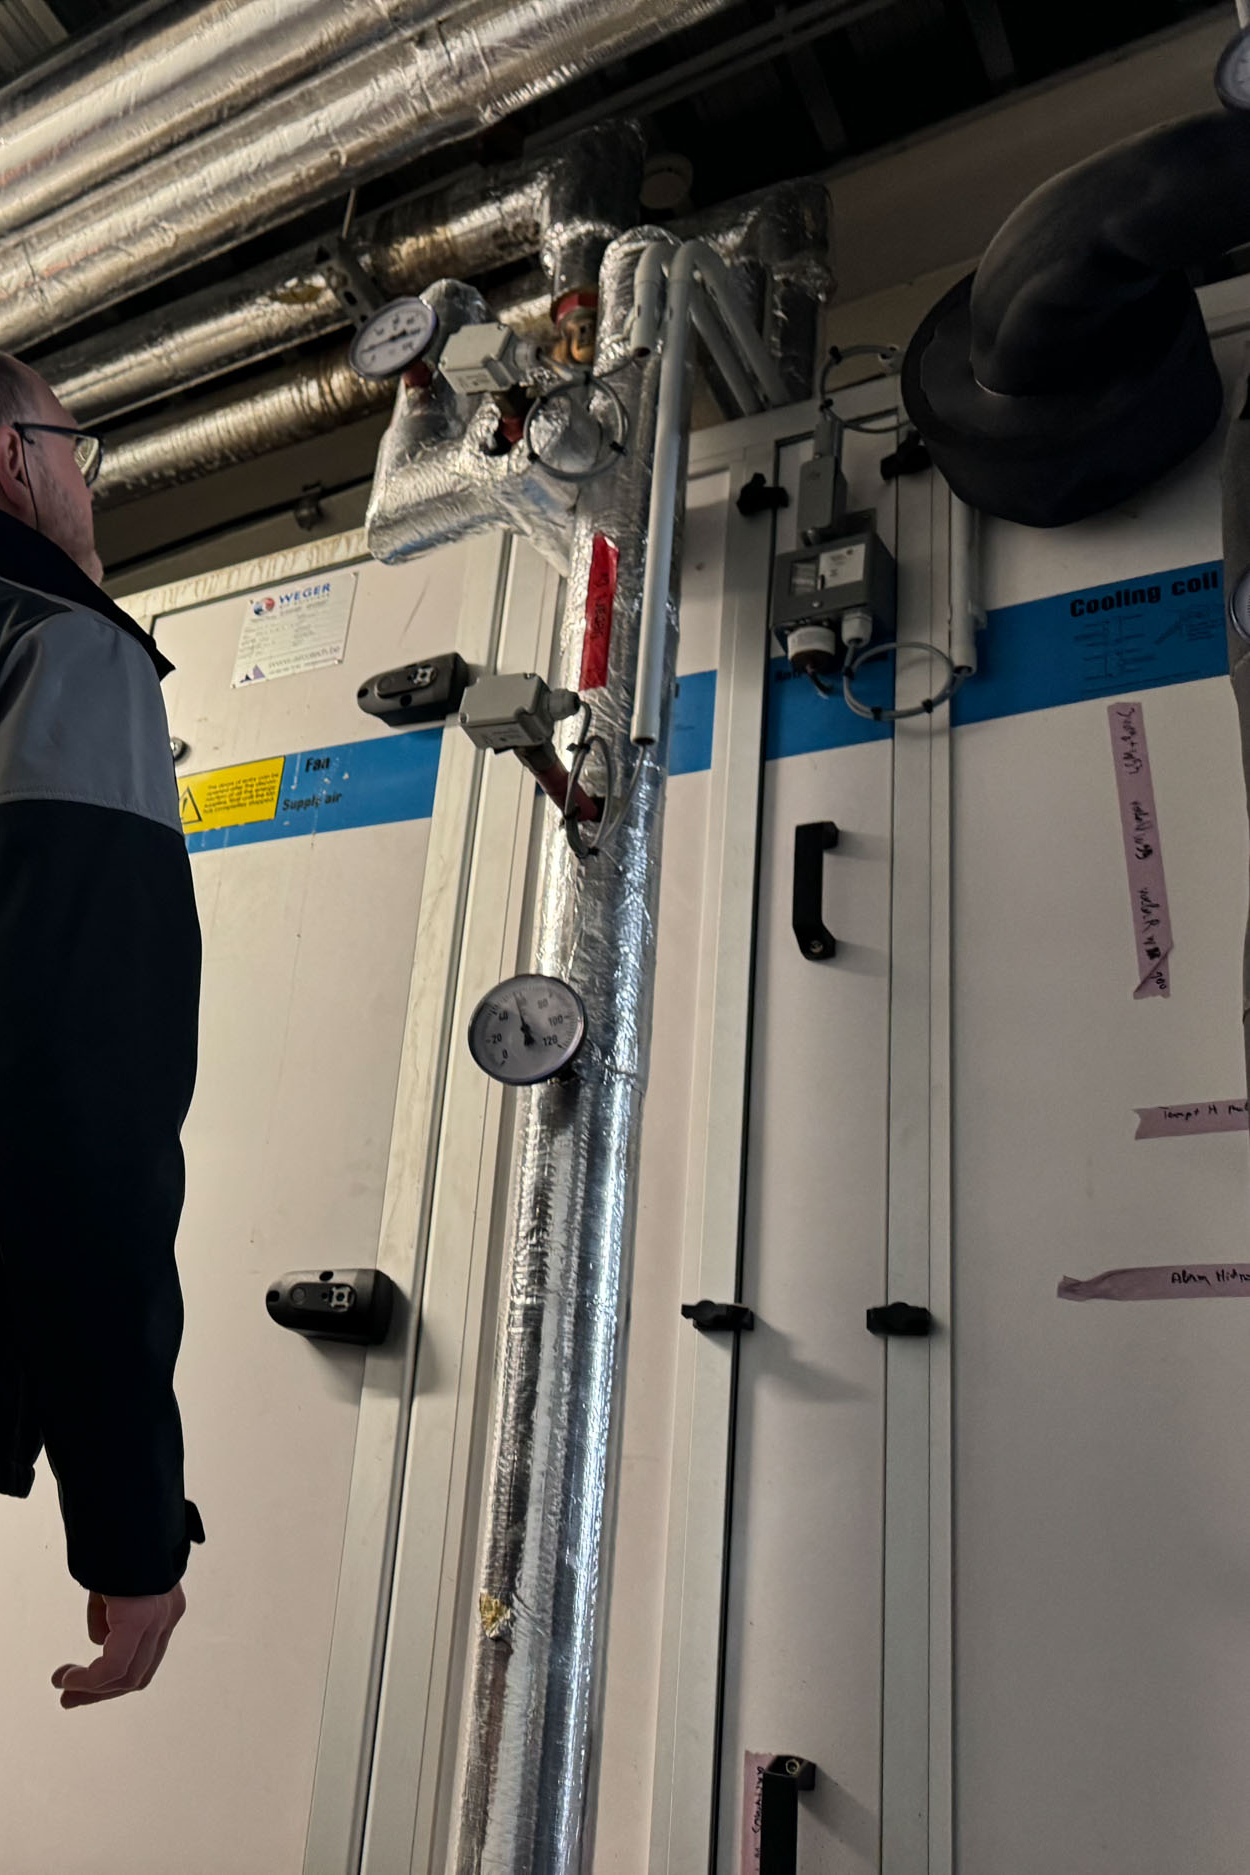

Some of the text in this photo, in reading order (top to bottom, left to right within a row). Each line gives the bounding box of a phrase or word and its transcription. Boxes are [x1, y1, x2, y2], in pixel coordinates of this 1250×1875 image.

[279, 583, 331, 603] WEGER
[1070, 570, 1218, 617] Cooling coil
[305, 757, 330, 772] Fan
[282, 794, 321, 811] Supply
[325, 791, 342, 804] air
[548, 1014, 563, 1026] 100
[491, 1033, 502, 1044] 20
[543, 1034, 558, 1046] 120
[502, 1048, 508, 1059] 0
